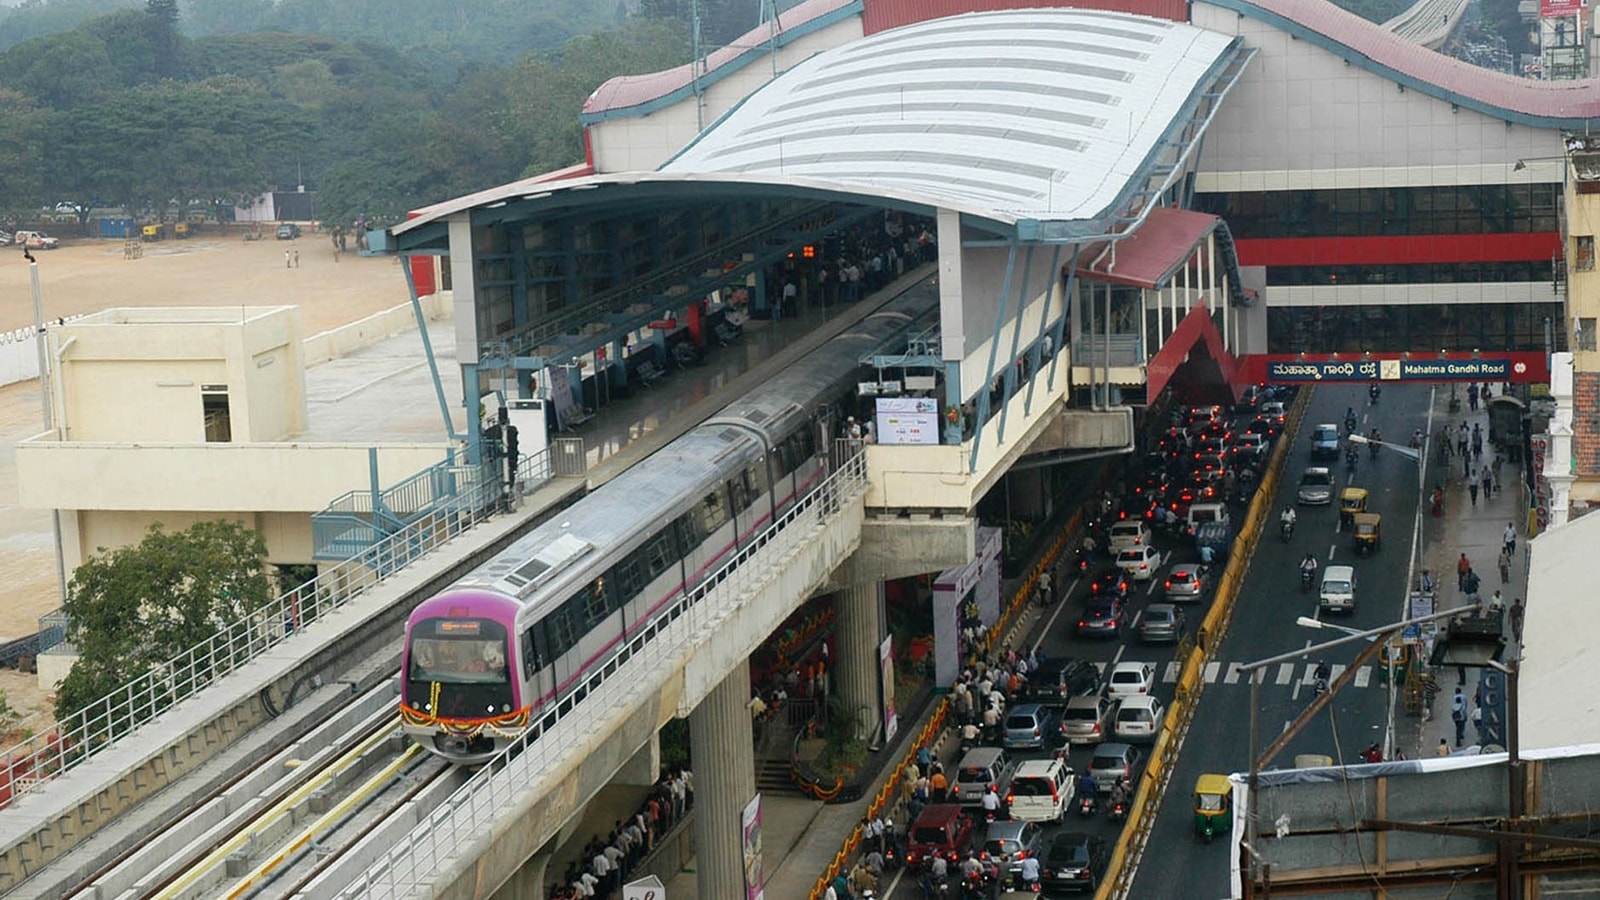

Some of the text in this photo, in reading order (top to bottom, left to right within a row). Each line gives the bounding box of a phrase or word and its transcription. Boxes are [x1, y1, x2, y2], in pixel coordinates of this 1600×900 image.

[1323, 363, 1354, 376] ಗಾಂಧಿ
[1360, 362, 1377, 378] ರಸ್ತೆ
[1405, 363, 1504, 374] Mahatma Gandhi Road
